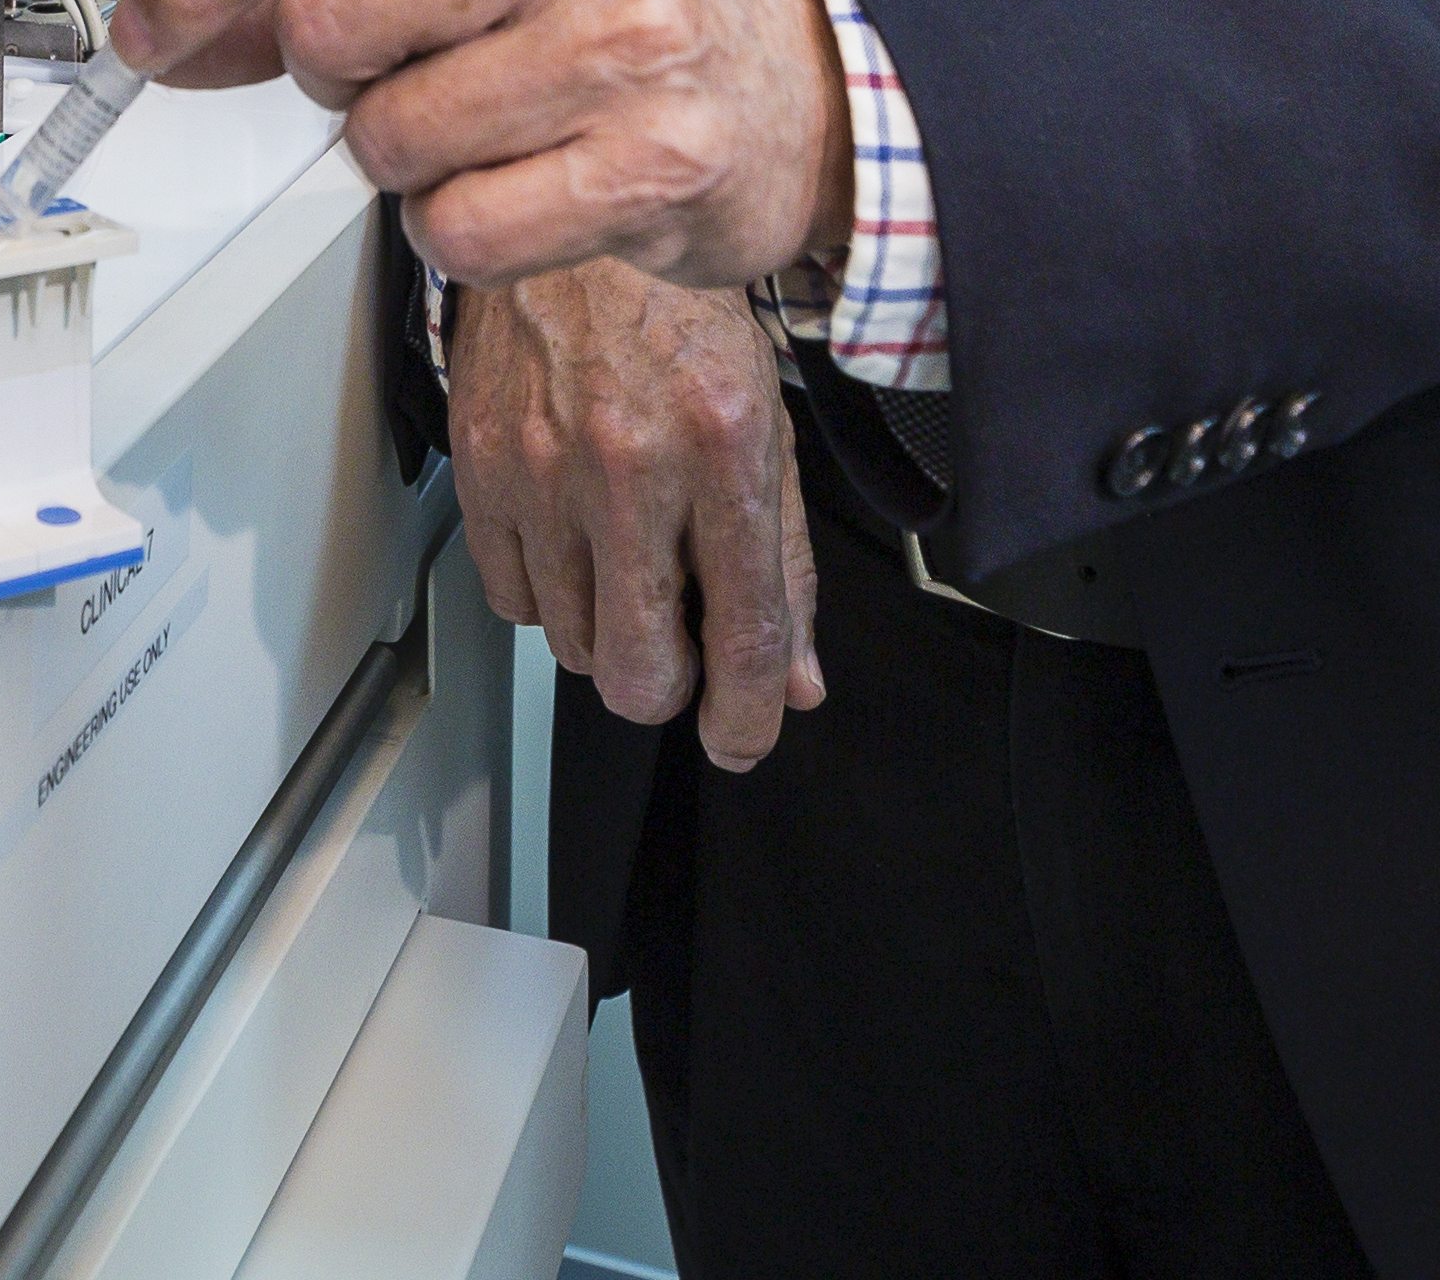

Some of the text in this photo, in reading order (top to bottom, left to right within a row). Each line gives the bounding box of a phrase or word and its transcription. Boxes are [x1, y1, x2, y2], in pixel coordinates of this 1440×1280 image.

[146, 528, 155, 563] 7
[37, 622, 171, 809] ENGINEERING USE ONLY
